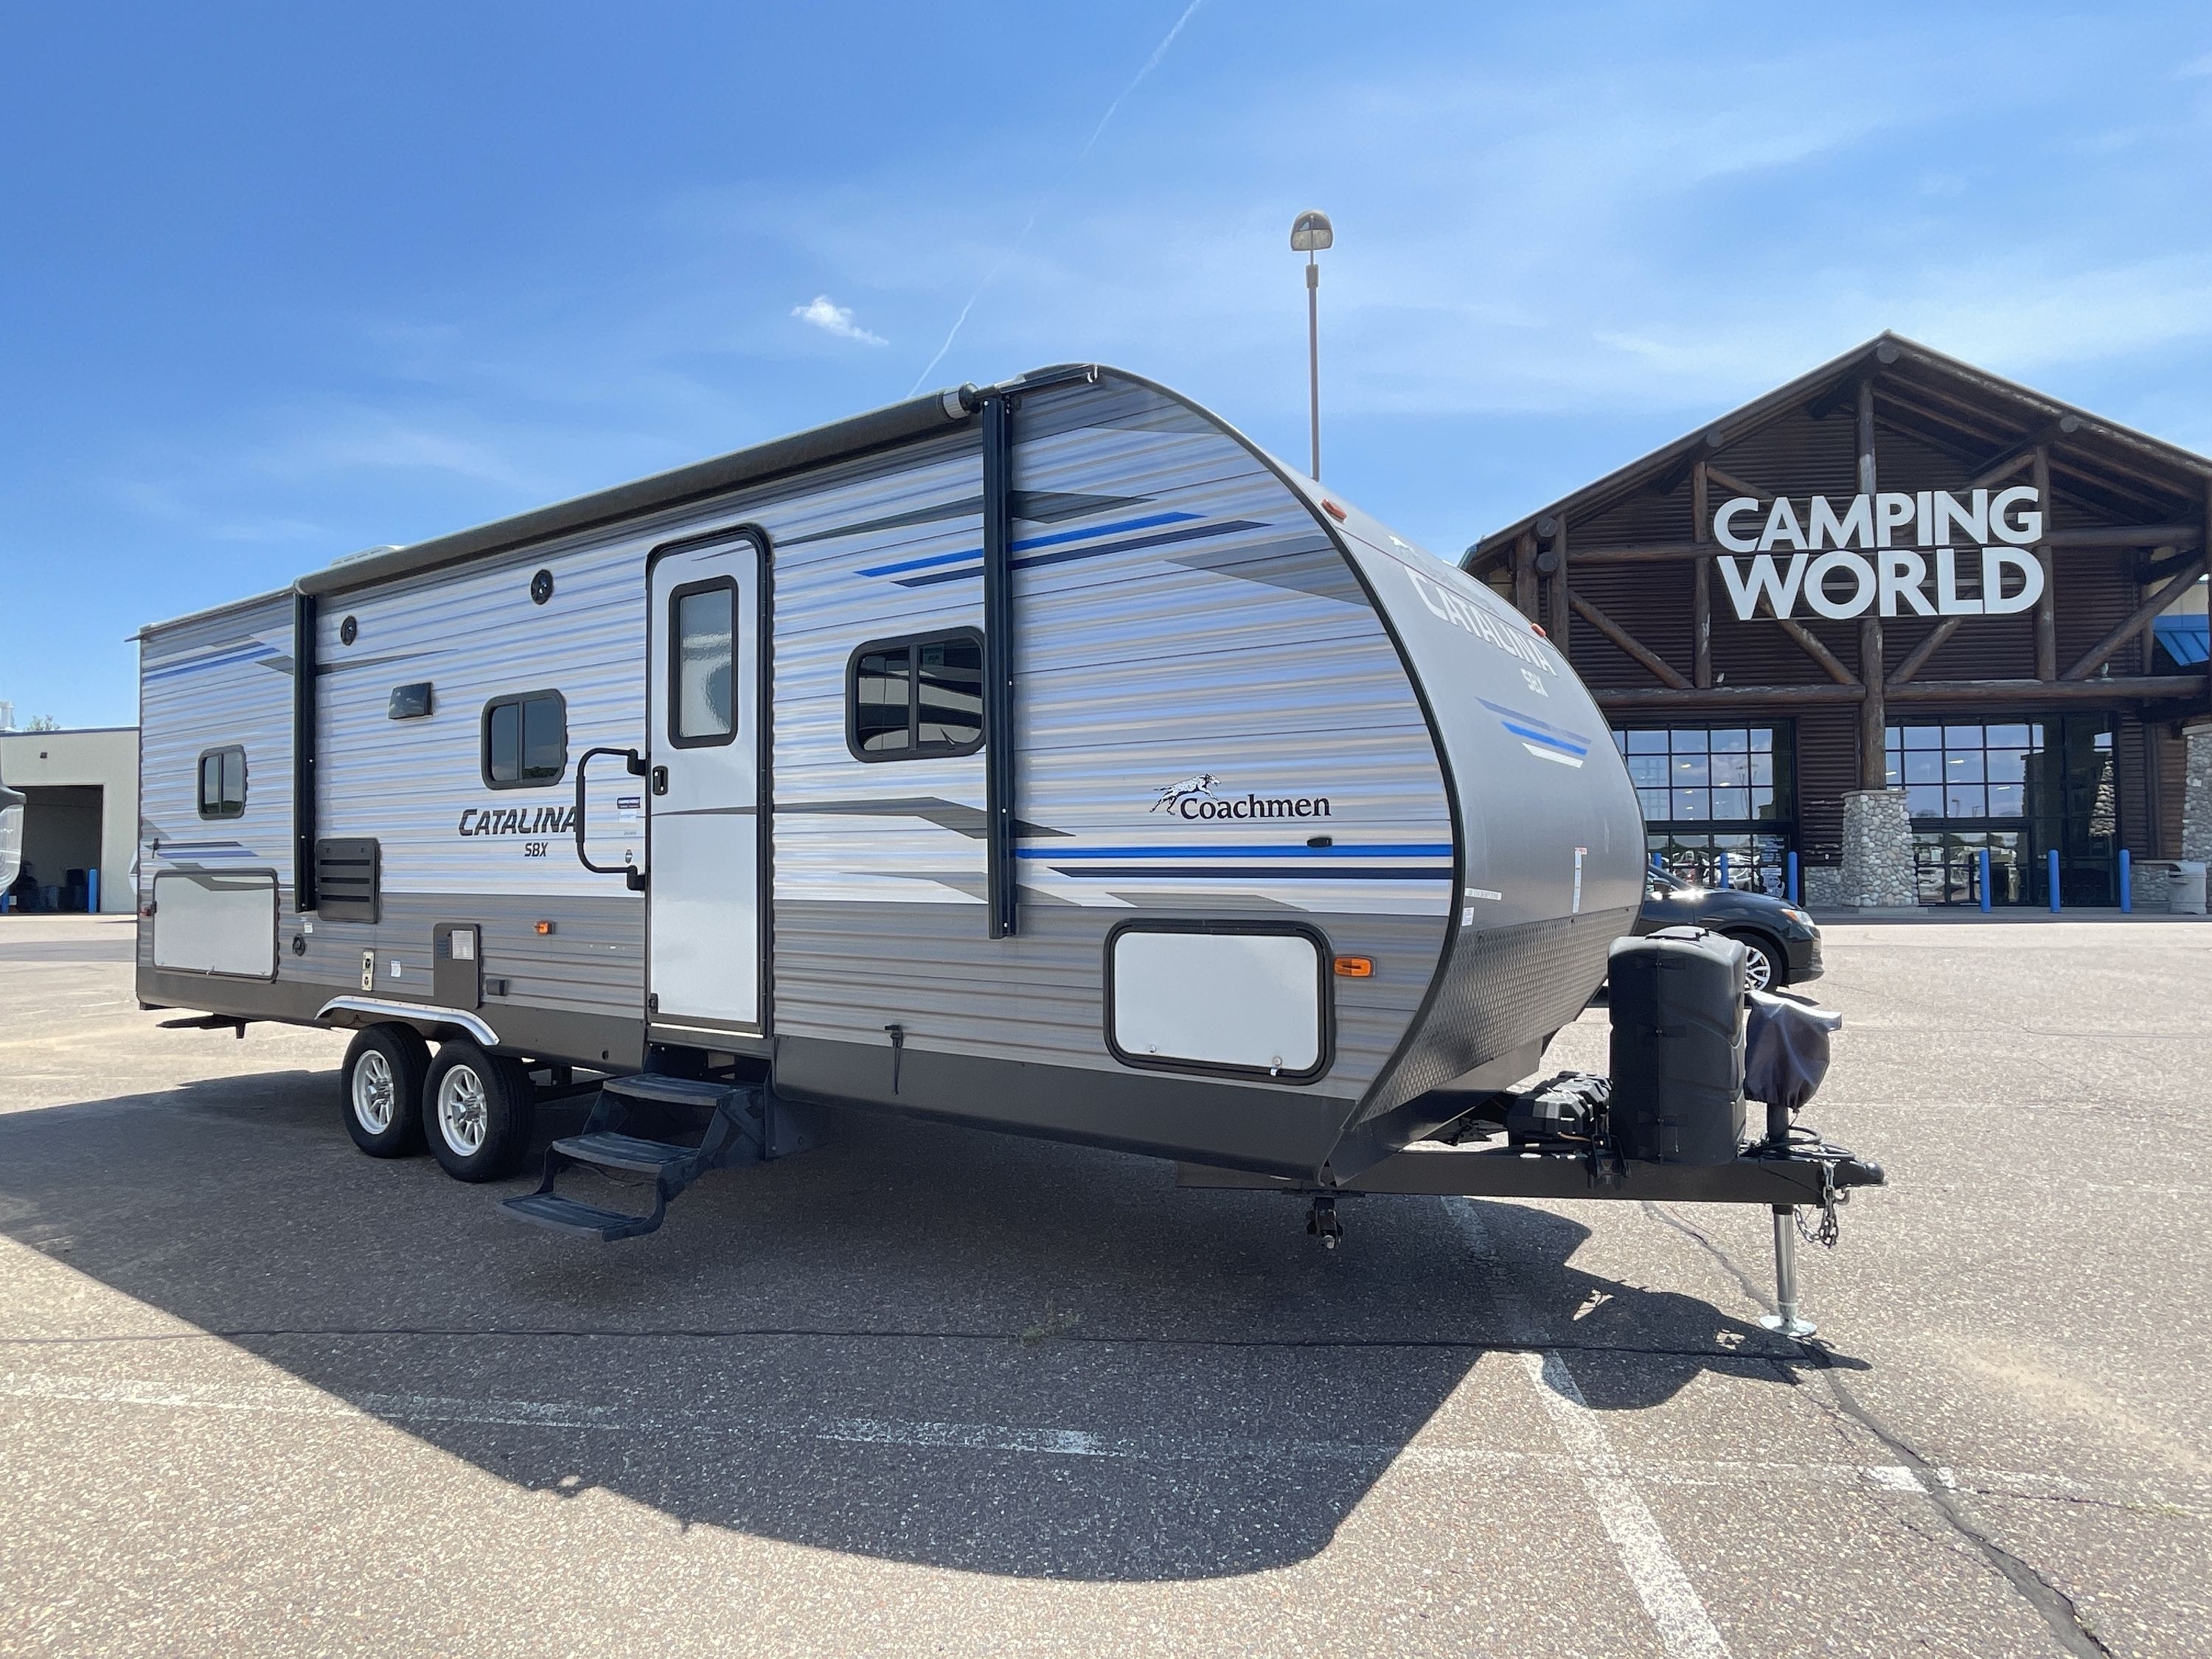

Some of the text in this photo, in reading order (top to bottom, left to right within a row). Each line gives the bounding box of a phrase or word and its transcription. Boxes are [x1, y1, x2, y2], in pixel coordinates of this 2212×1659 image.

[1713, 485, 2043, 553] CAMPING
[1716, 546, 2045, 621] WORLD
[1403, 565, 1558, 678] CATALINA
[458, 805, 577, 837] CATALINA
[1180, 793, 1332, 820] Coachmen
[524, 842, 549, 858] SBX
